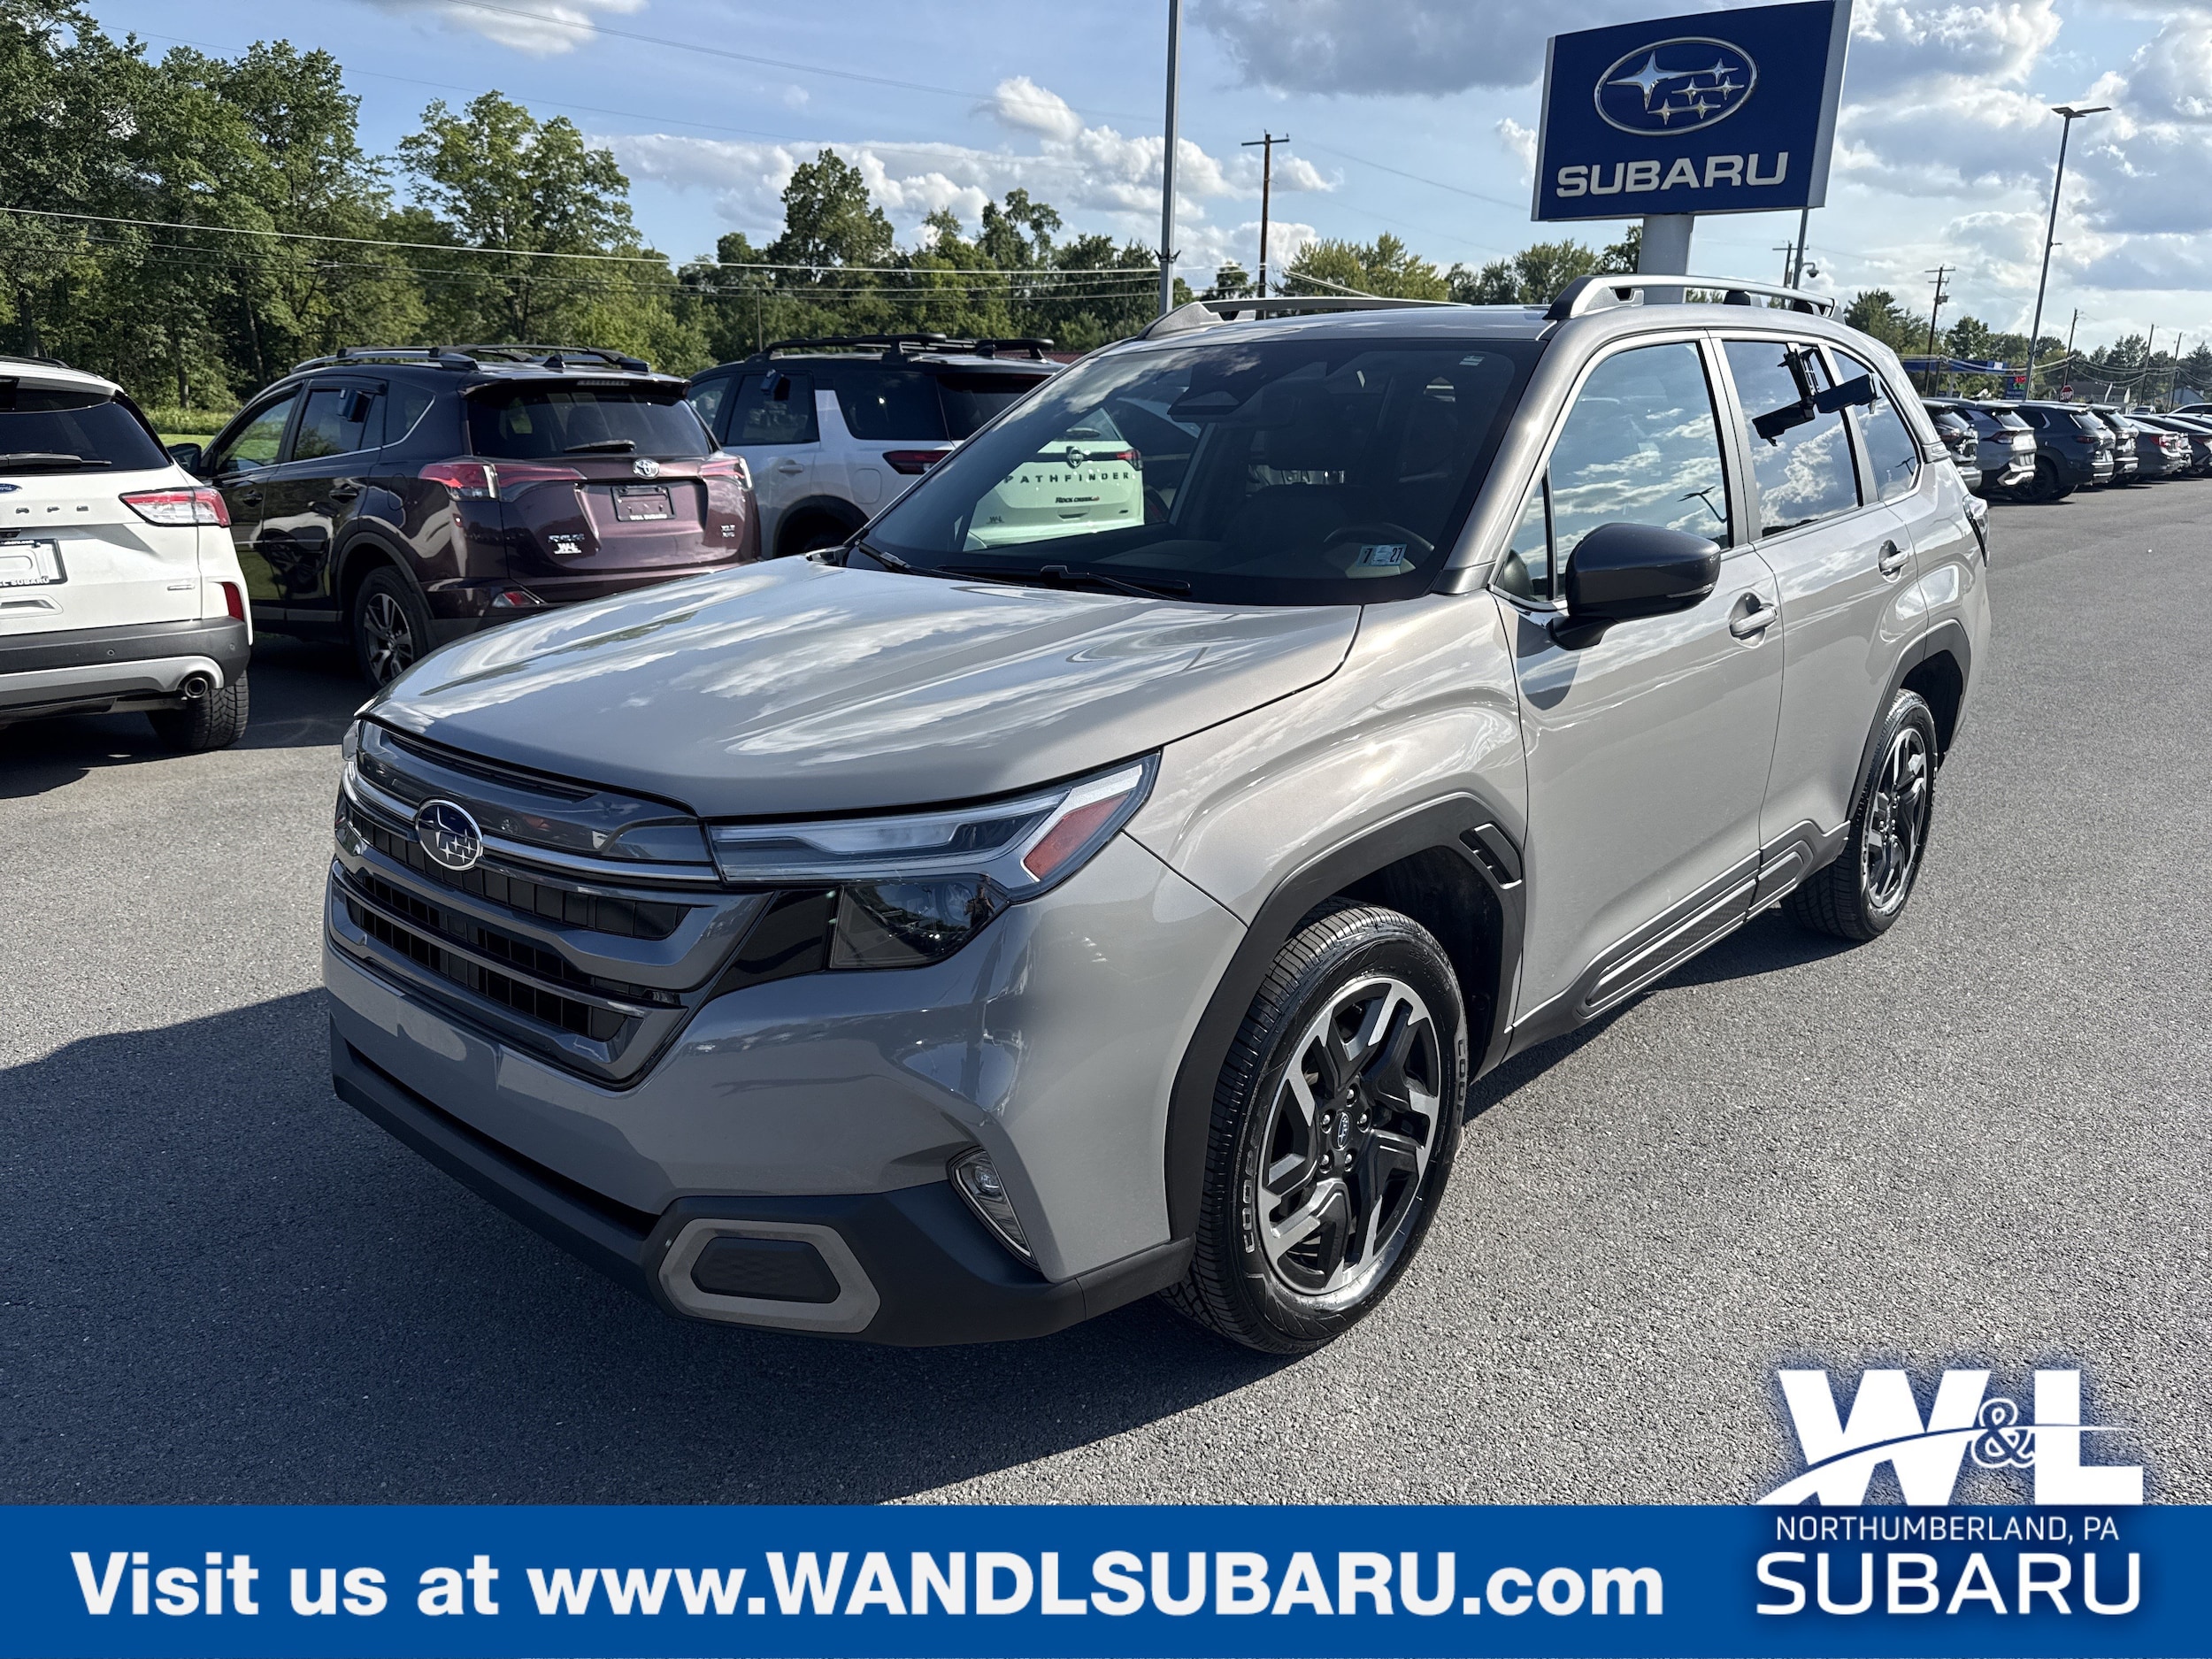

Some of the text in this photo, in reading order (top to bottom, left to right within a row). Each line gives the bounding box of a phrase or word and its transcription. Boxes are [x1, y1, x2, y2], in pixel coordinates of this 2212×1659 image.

[1555, 151, 1789, 198] SUBARU
[1003, 472, 1130, 484] PATHFINDER
[1363, 547, 1402, 563] 7 27
